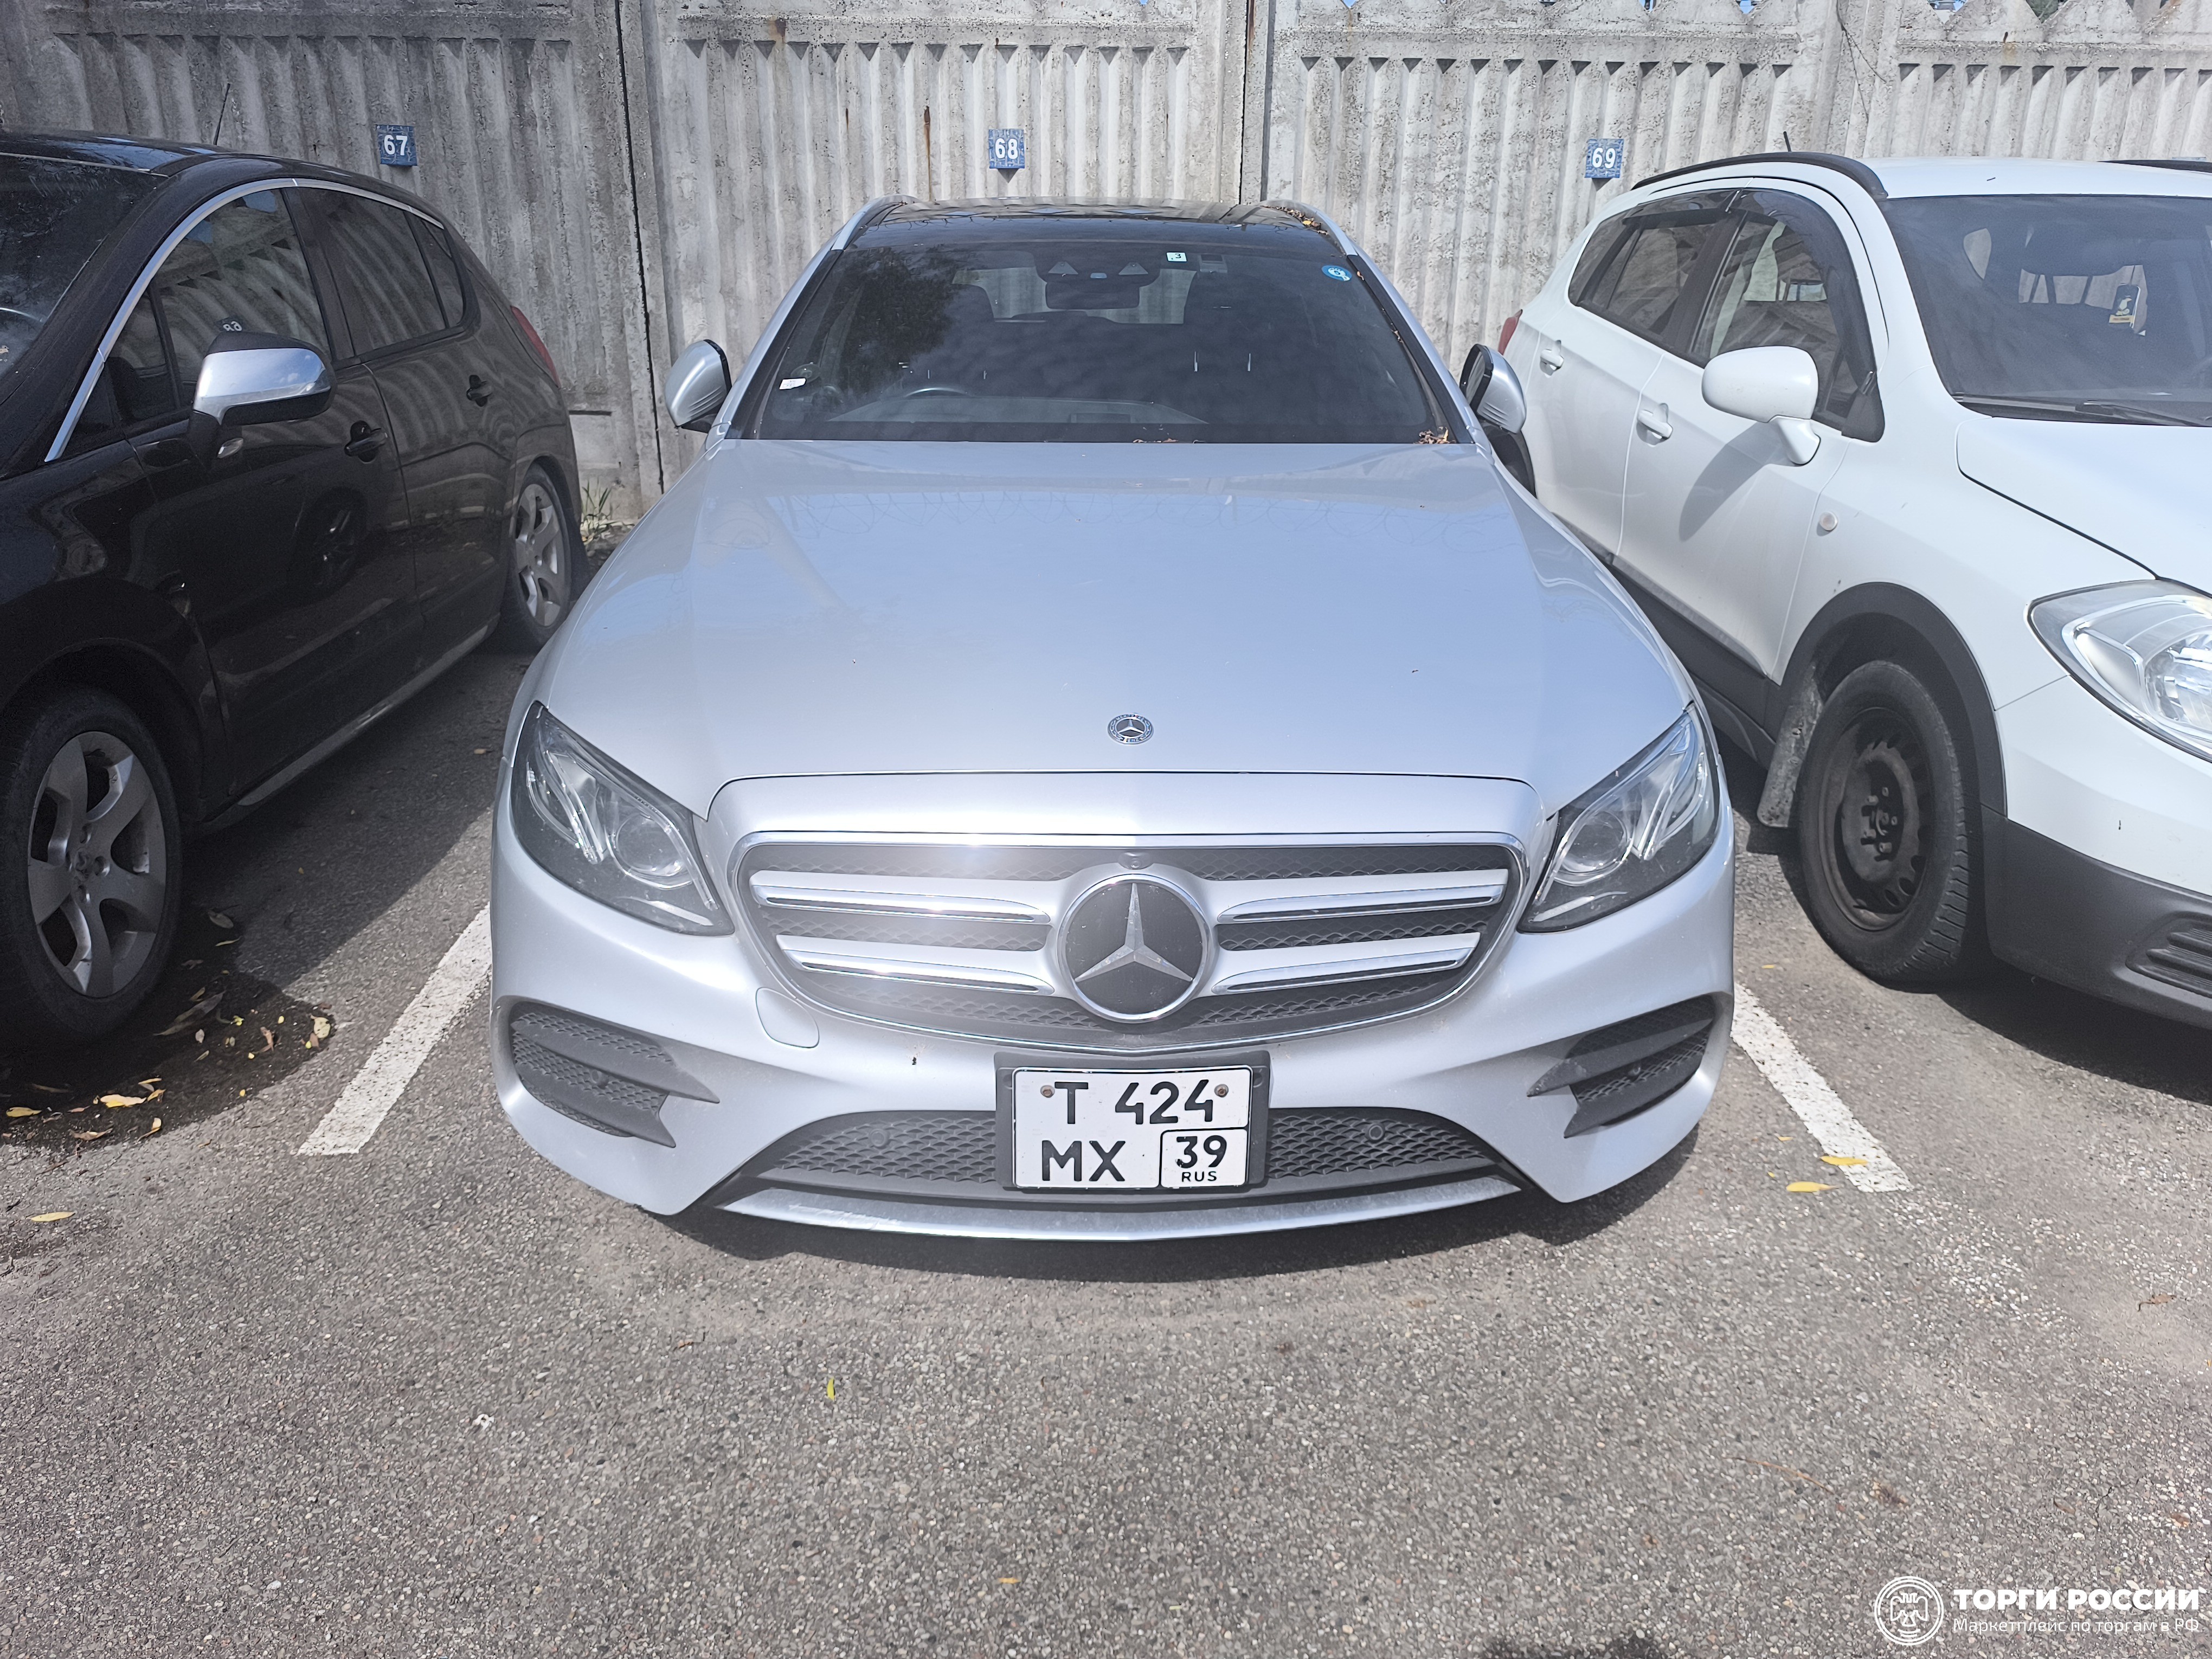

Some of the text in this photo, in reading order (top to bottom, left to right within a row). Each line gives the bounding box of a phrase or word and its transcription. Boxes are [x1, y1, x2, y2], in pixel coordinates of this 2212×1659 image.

[384, 134, 408, 156] 67
[995, 138, 1018, 159] 68
[1592, 147, 1616, 169] 69
[1115, 1079, 1213, 1125] 424
[1176, 1135, 1227, 1169] 39
[1181, 1171, 1218, 1182] RUS
